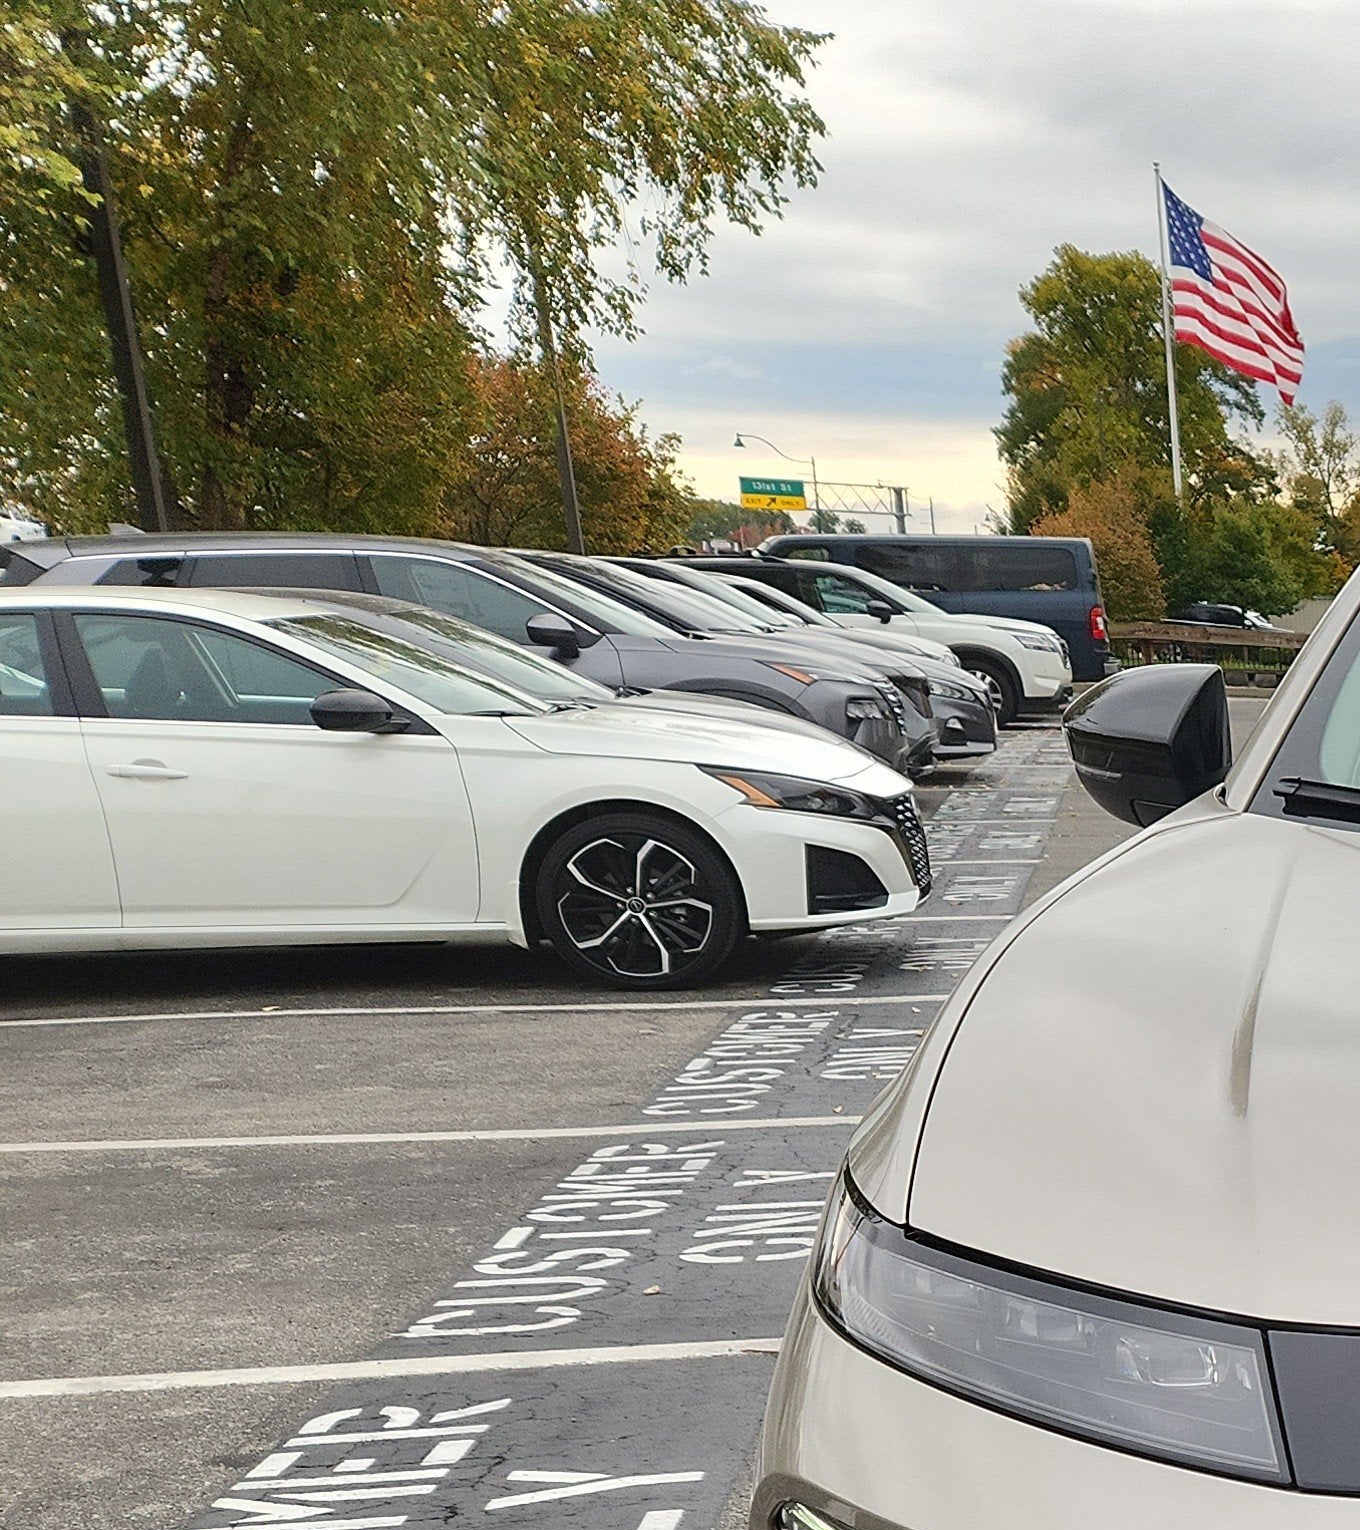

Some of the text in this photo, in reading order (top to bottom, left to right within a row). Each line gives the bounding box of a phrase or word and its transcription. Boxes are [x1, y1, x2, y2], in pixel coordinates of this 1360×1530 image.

[752, 481, 792, 492] 131st St
[780, 499, 801, 507] ONLY
[642, 1010, 840, 1116] CUSTOMER
[400, 1140, 725, 1338] CUSTOMER
